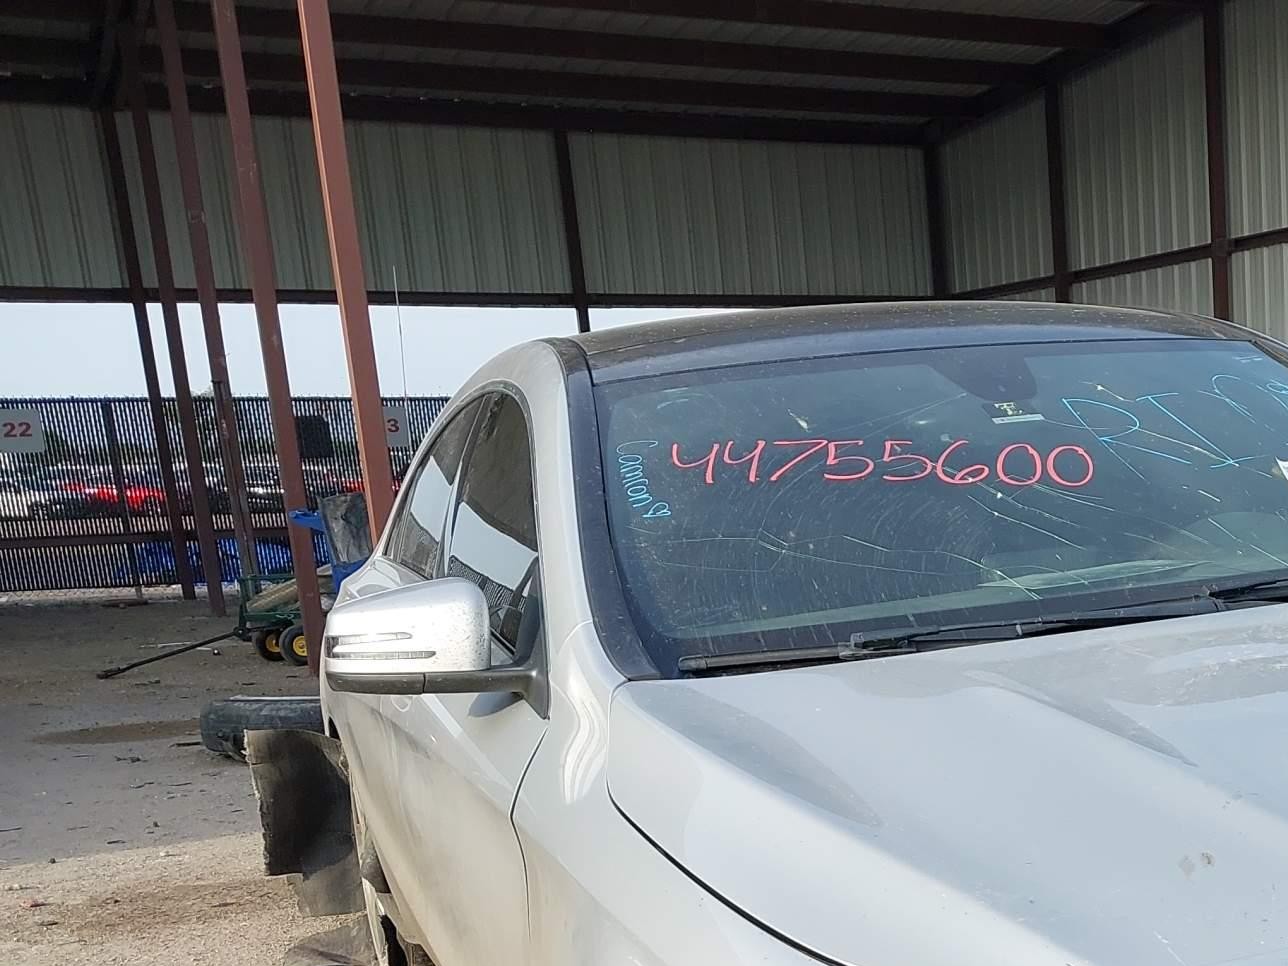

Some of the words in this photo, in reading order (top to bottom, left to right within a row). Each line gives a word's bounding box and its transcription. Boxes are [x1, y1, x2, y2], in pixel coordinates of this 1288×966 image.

[2, 422, 33, 438] 22
[386, 418, 400, 433] 3
[671, 438, 1095, 487] 44755600
